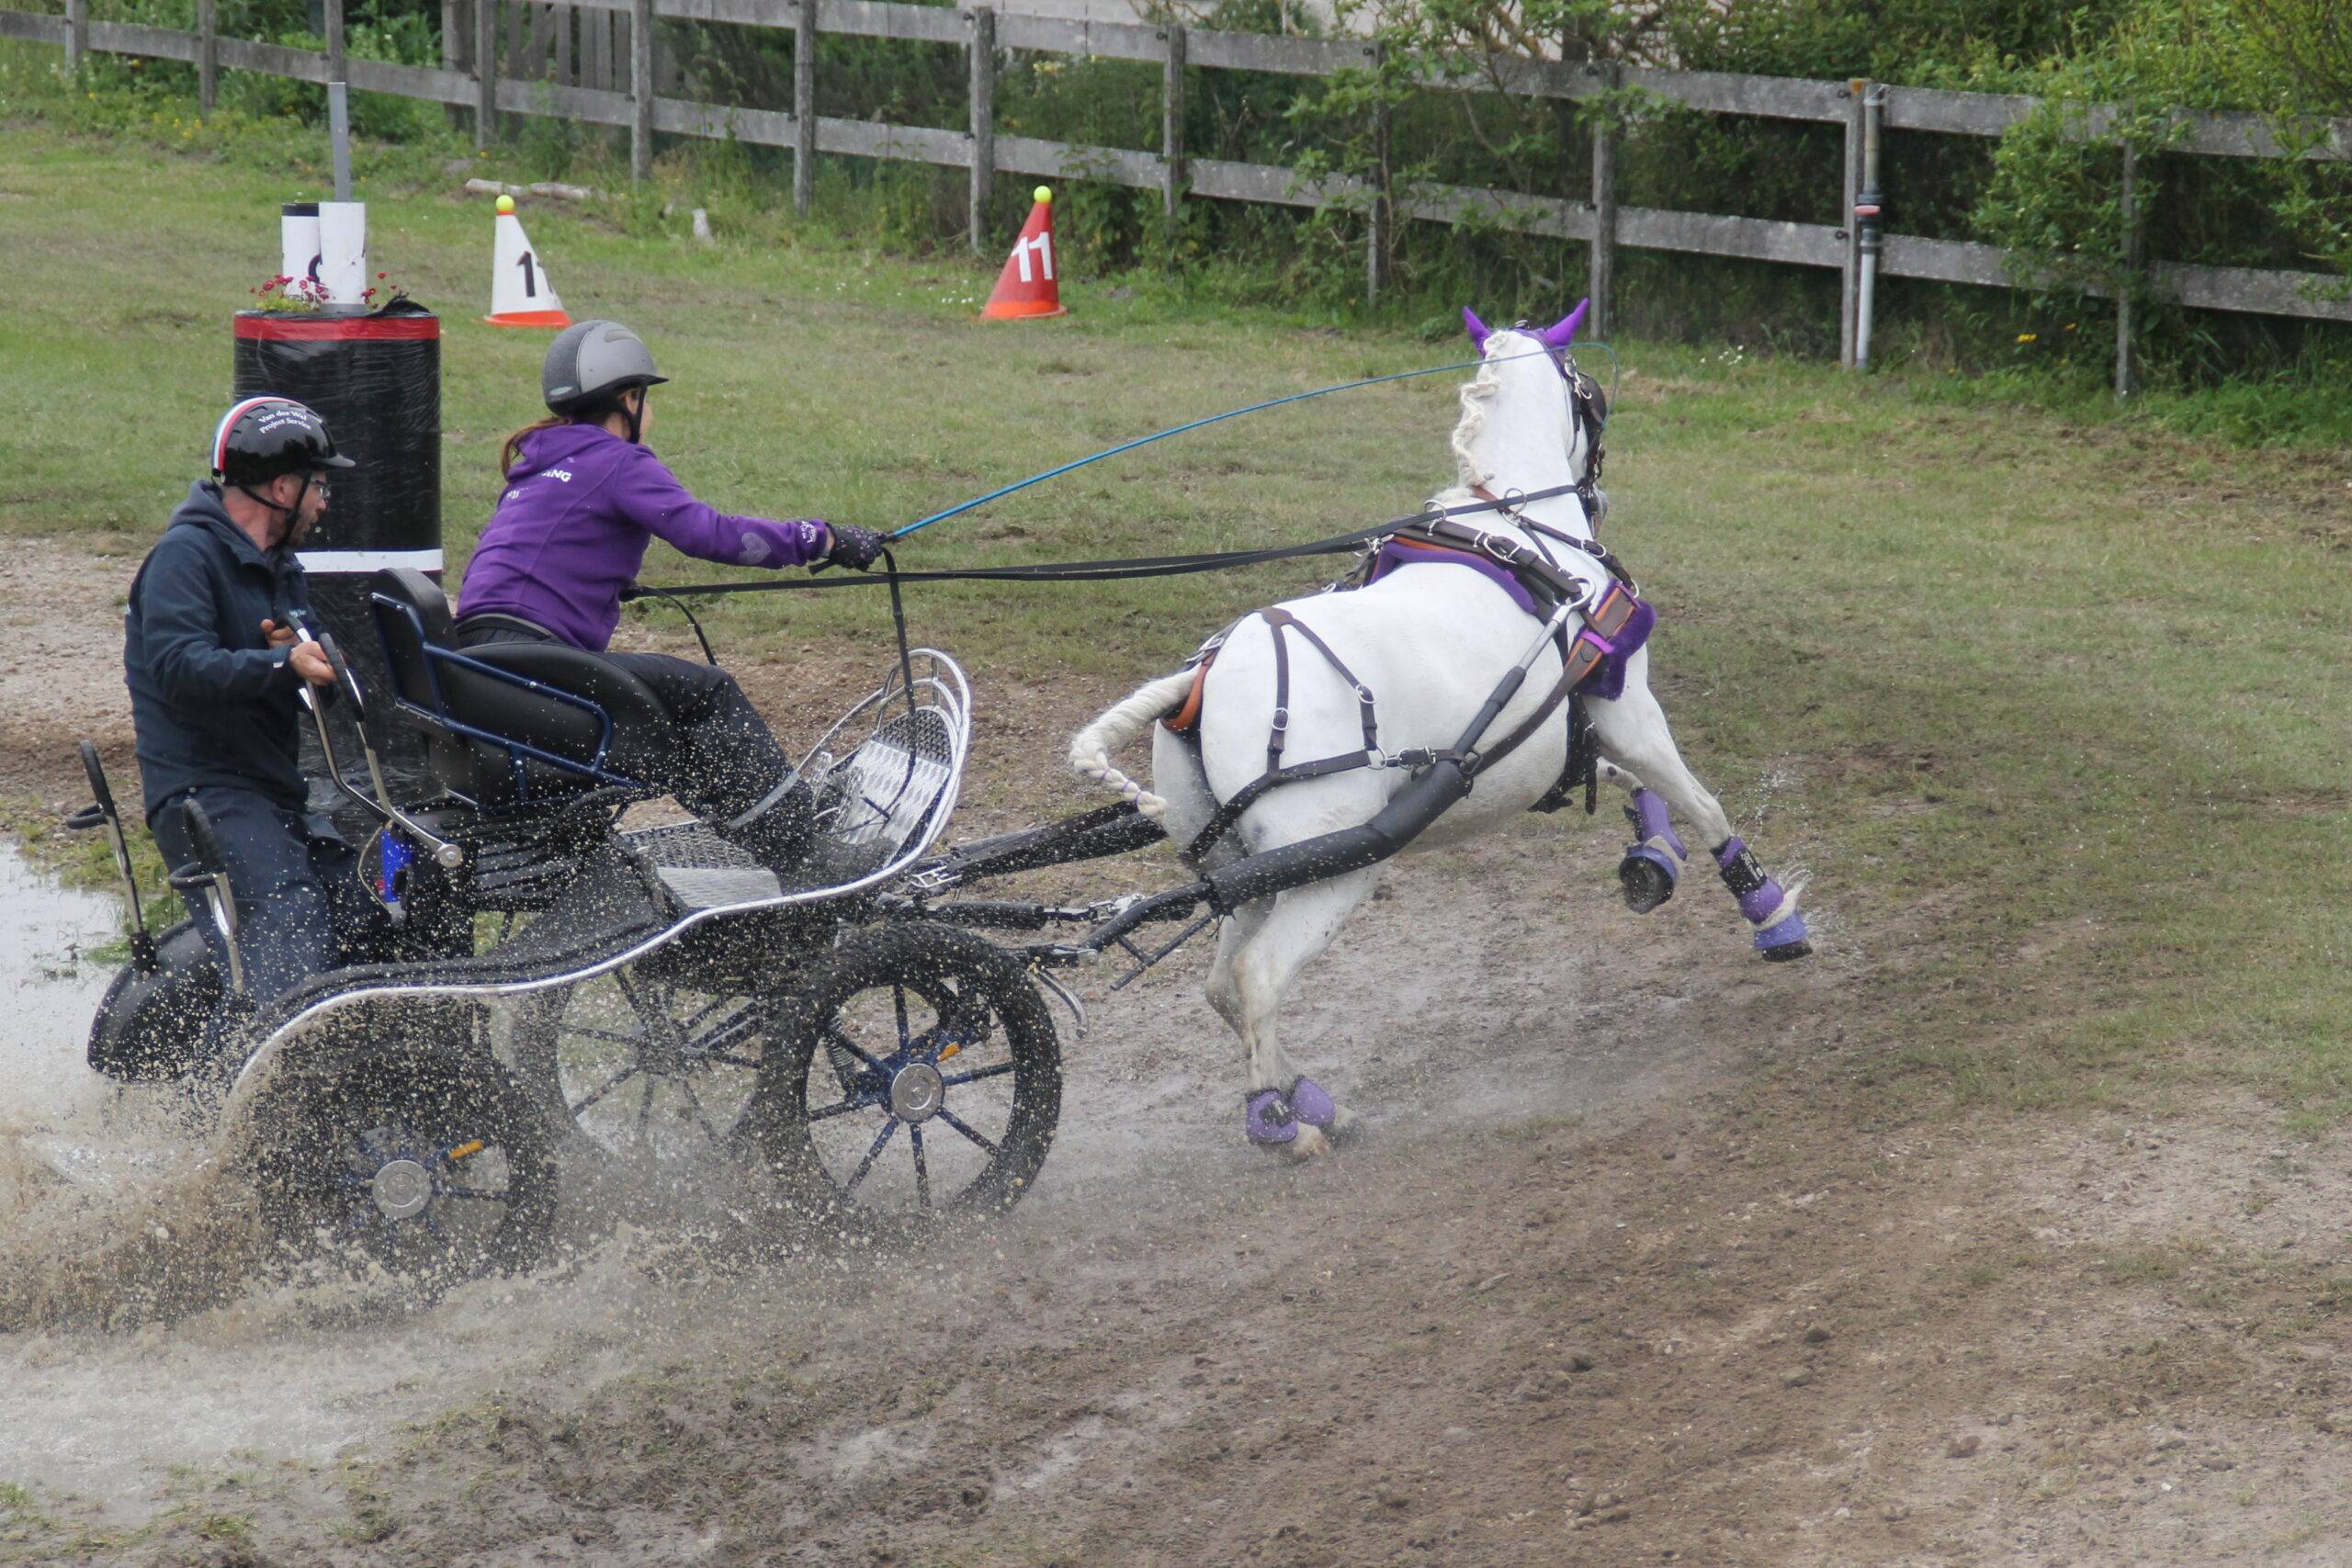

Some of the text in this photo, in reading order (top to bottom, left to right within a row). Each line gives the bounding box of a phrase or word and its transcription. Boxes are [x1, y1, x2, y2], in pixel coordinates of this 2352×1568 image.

[1011, 231, 1053, 283] 11
[258, 413, 276, 423] Van
[290, 411, 308, 421] Wal
[259, 417, 311, 434] Project Service
